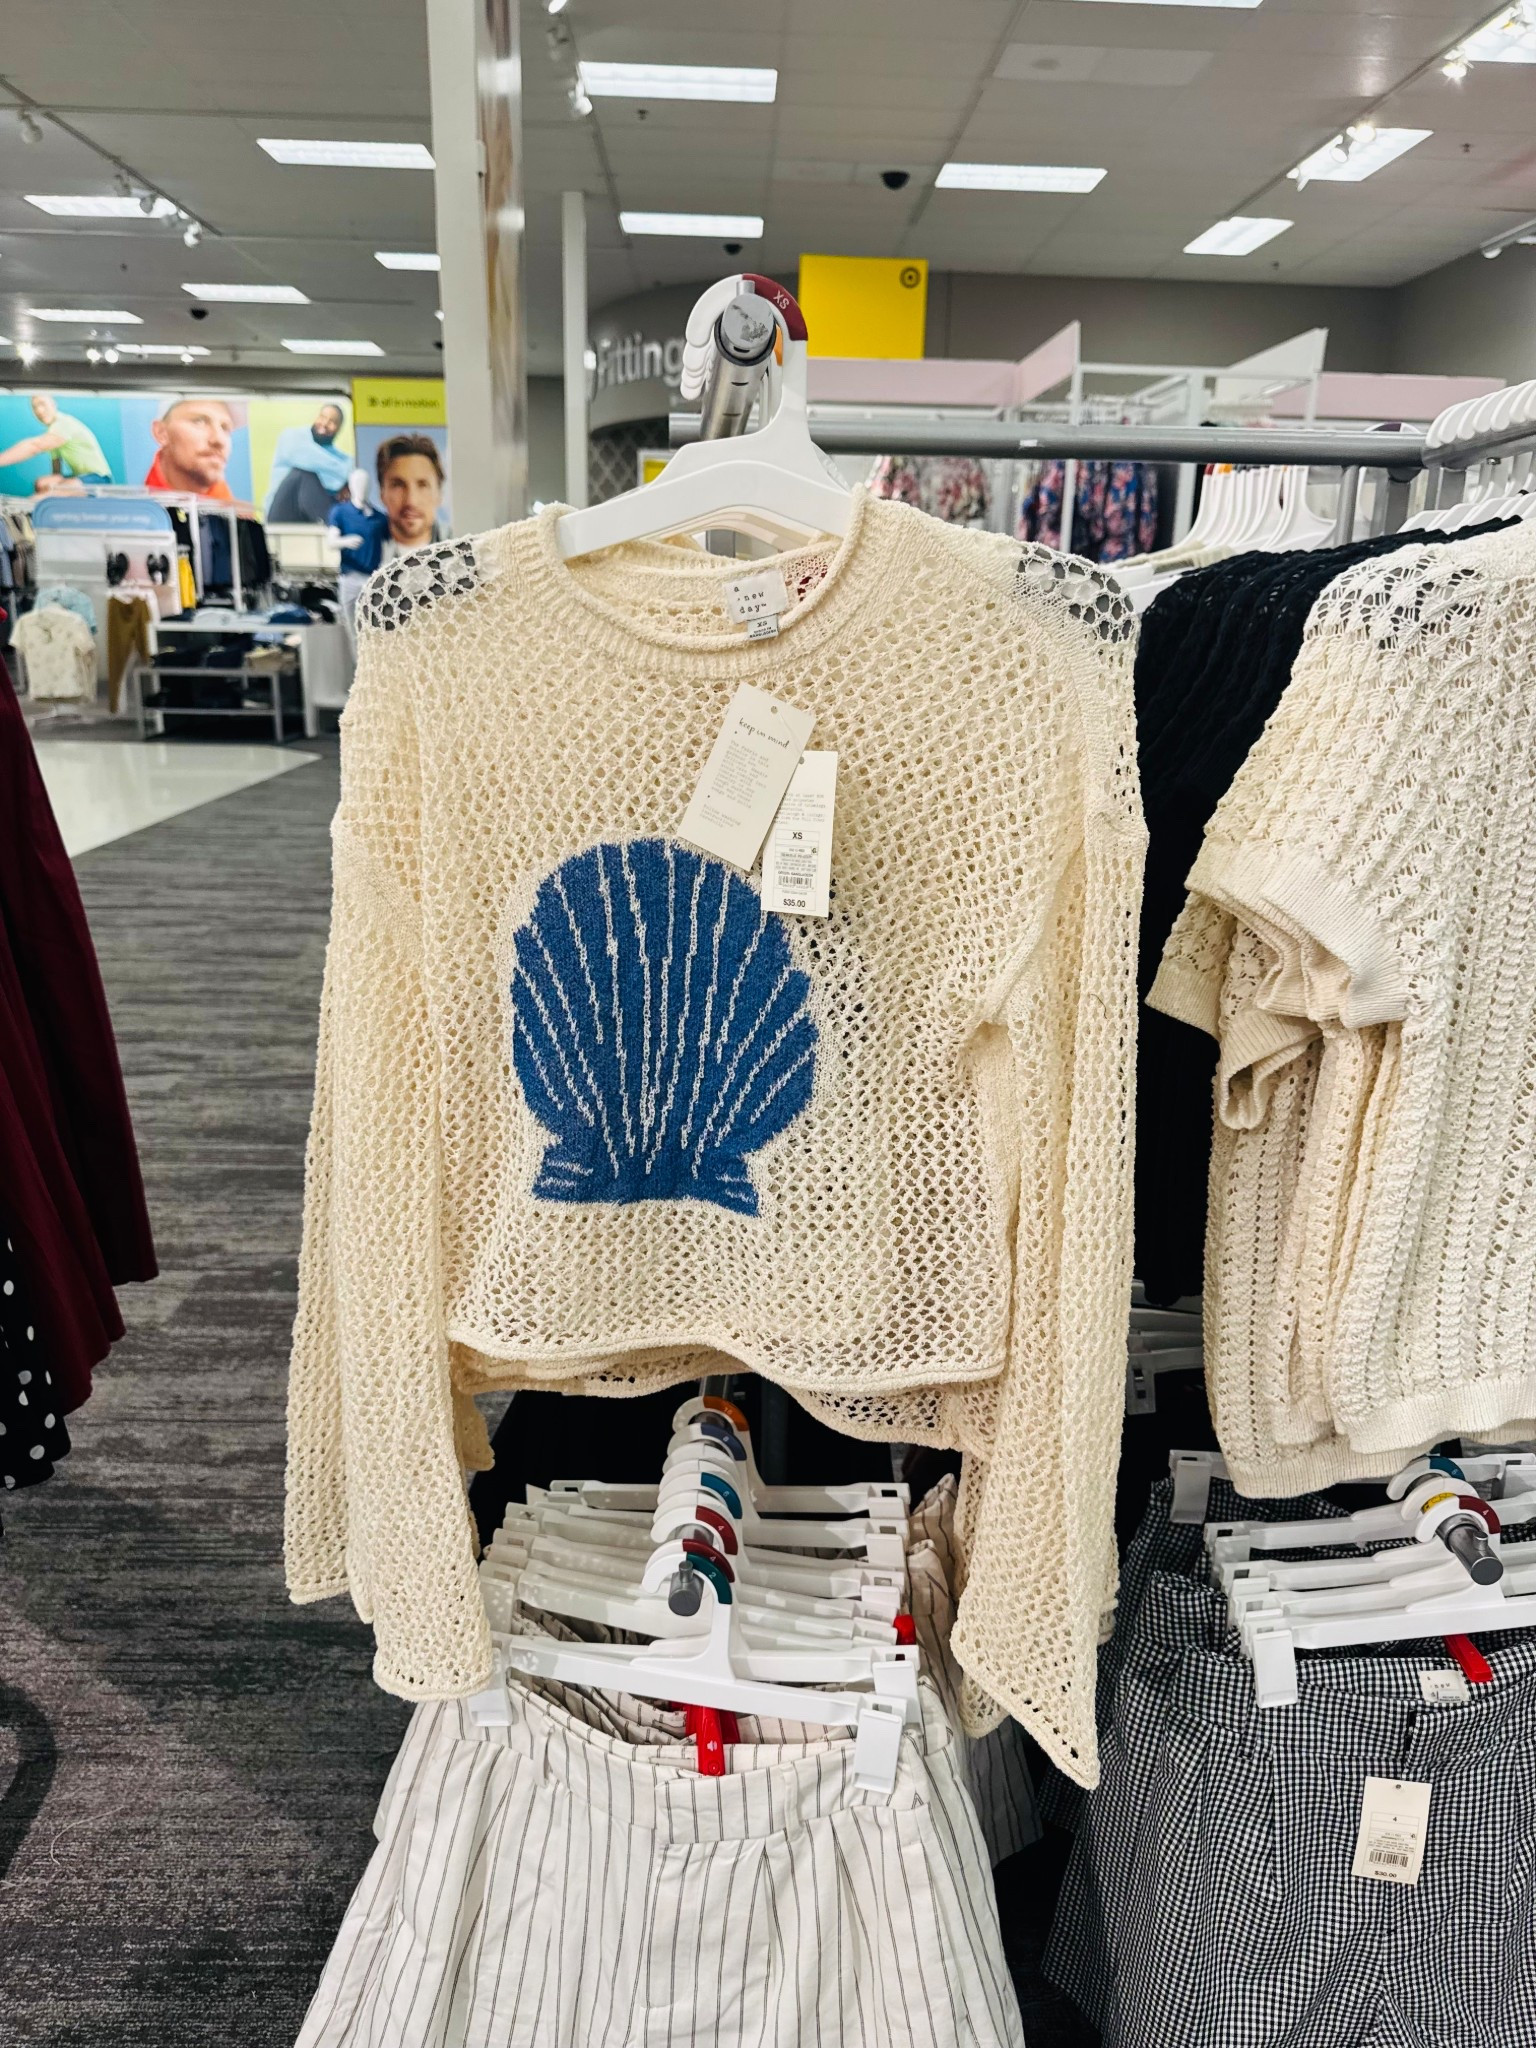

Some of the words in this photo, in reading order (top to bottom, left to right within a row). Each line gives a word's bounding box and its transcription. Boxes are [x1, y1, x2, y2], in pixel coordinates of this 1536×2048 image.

[773, 290, 790, 310] XS
[744, 592, 764, 601] new
[739, 717, 756, 736] keep
[757, 730, 766, 738] in
[768, 735, 790, 750] mind
[792, 831, 803, 840] XS
[783, 898, 807, 908] $35.00
[708, 1571, 717, 1579] 2
